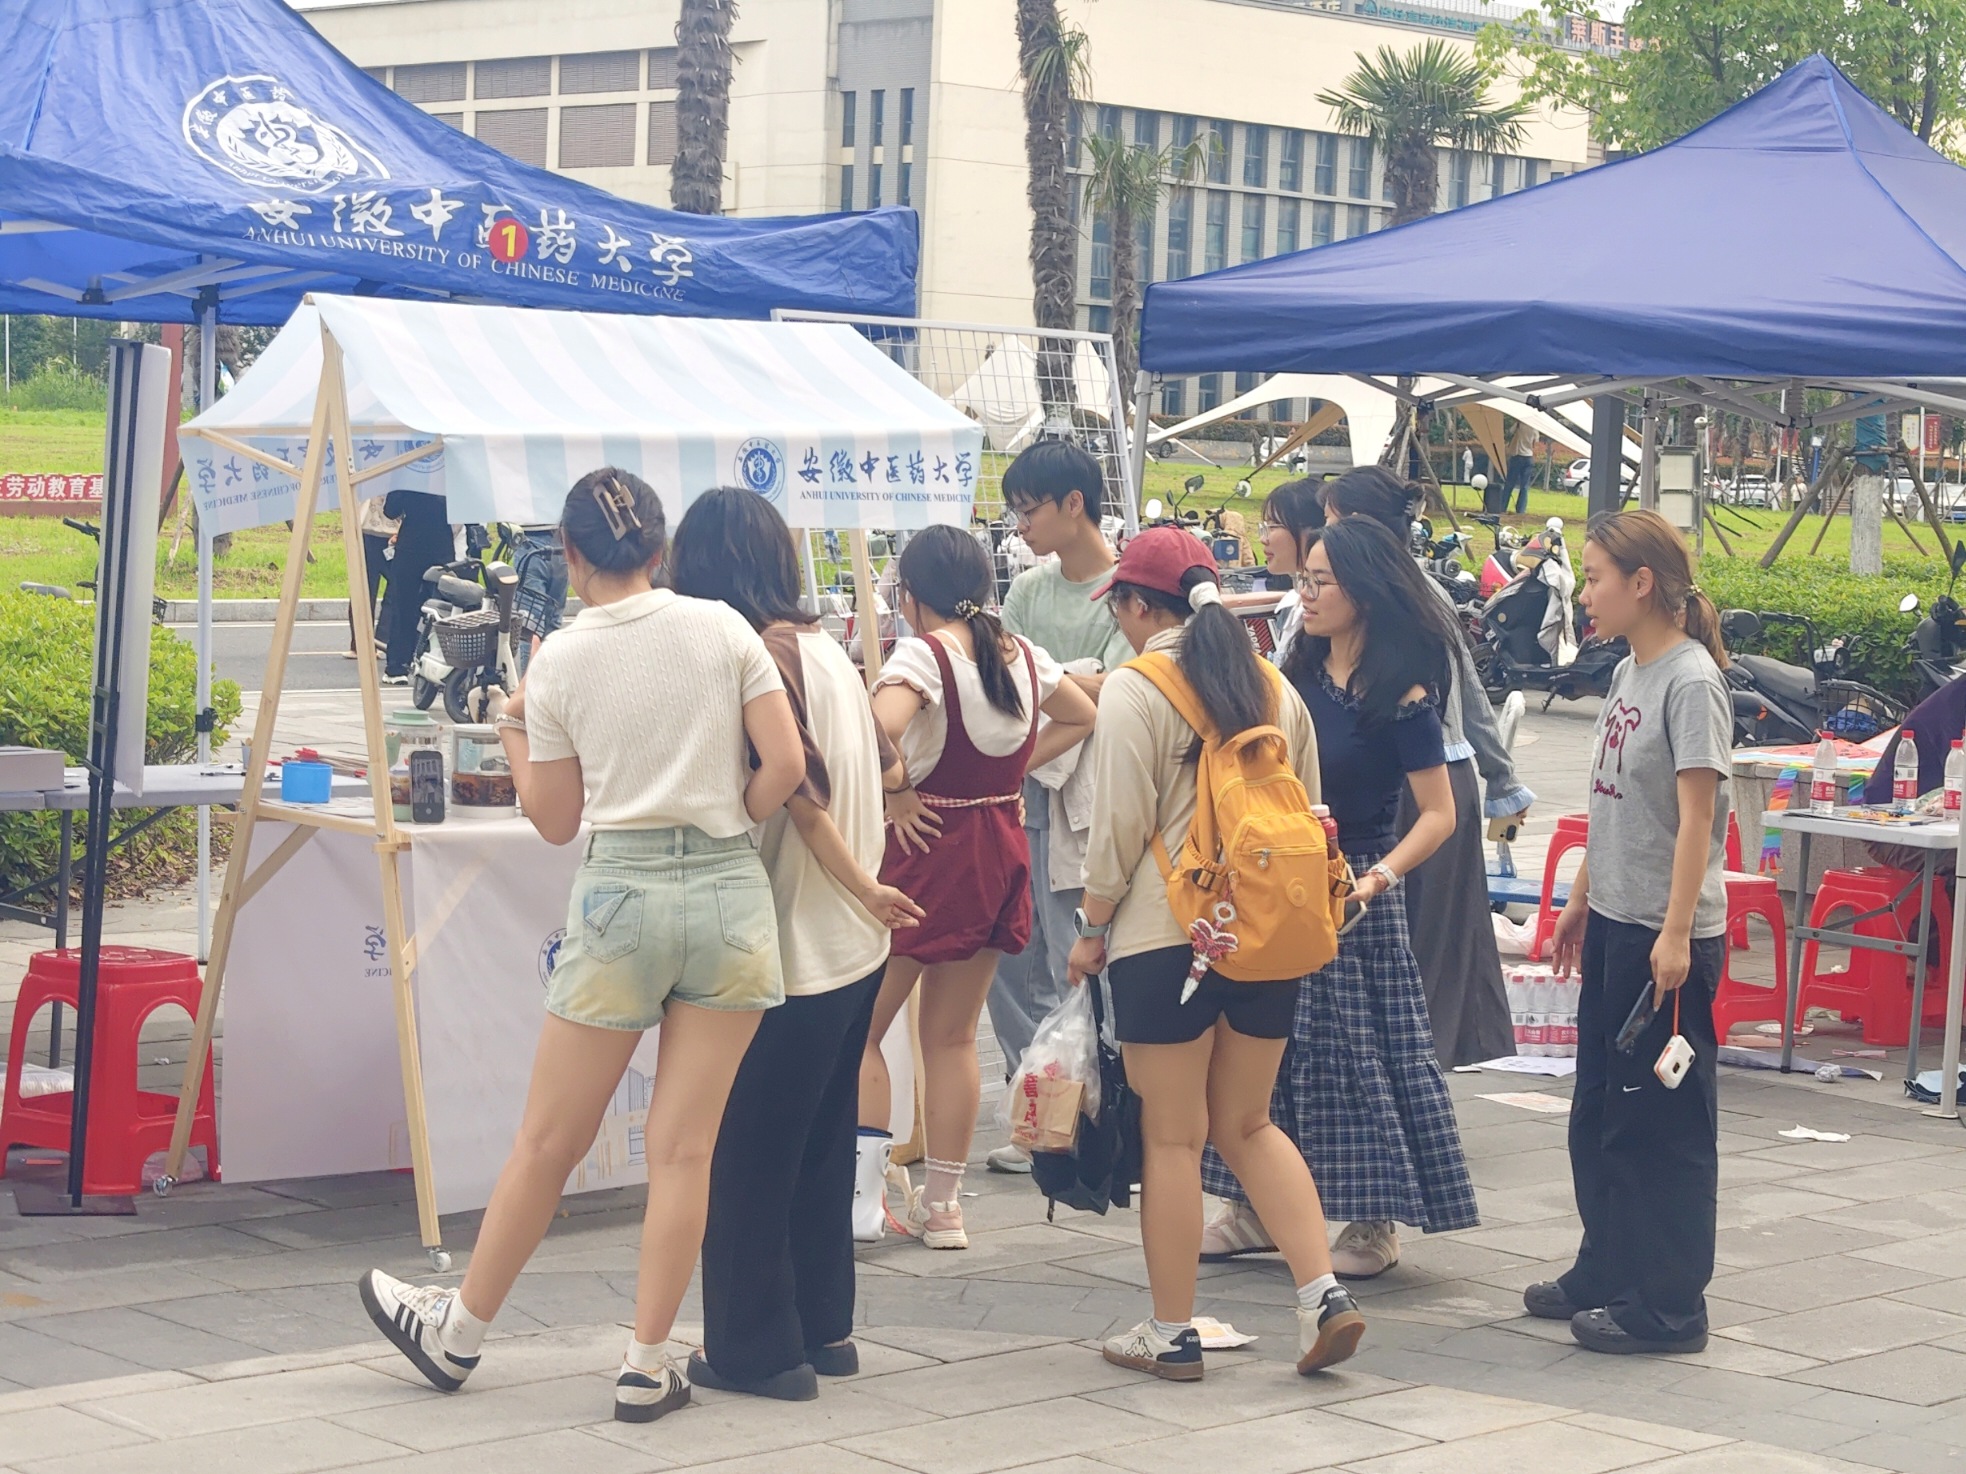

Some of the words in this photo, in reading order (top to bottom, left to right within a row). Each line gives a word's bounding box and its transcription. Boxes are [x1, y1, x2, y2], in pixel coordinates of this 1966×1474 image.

[242, 226, 316, 248] ANHUI
[321, 235, 450, 264] UNIVERSITY
[457, 252, 482, 270] OF
[491, 257, 580, 286] CHINESE
[502, 224, 517, 257] 1
[797, 446, 973, 487] 安徽中医药大学
[800, 490, 828, 500] ANHUI
[829, 491, 881, 501] UNIVERSITY
[882, 492, 895, 502] OF
[895, 492, 932, 503] CHINESE
